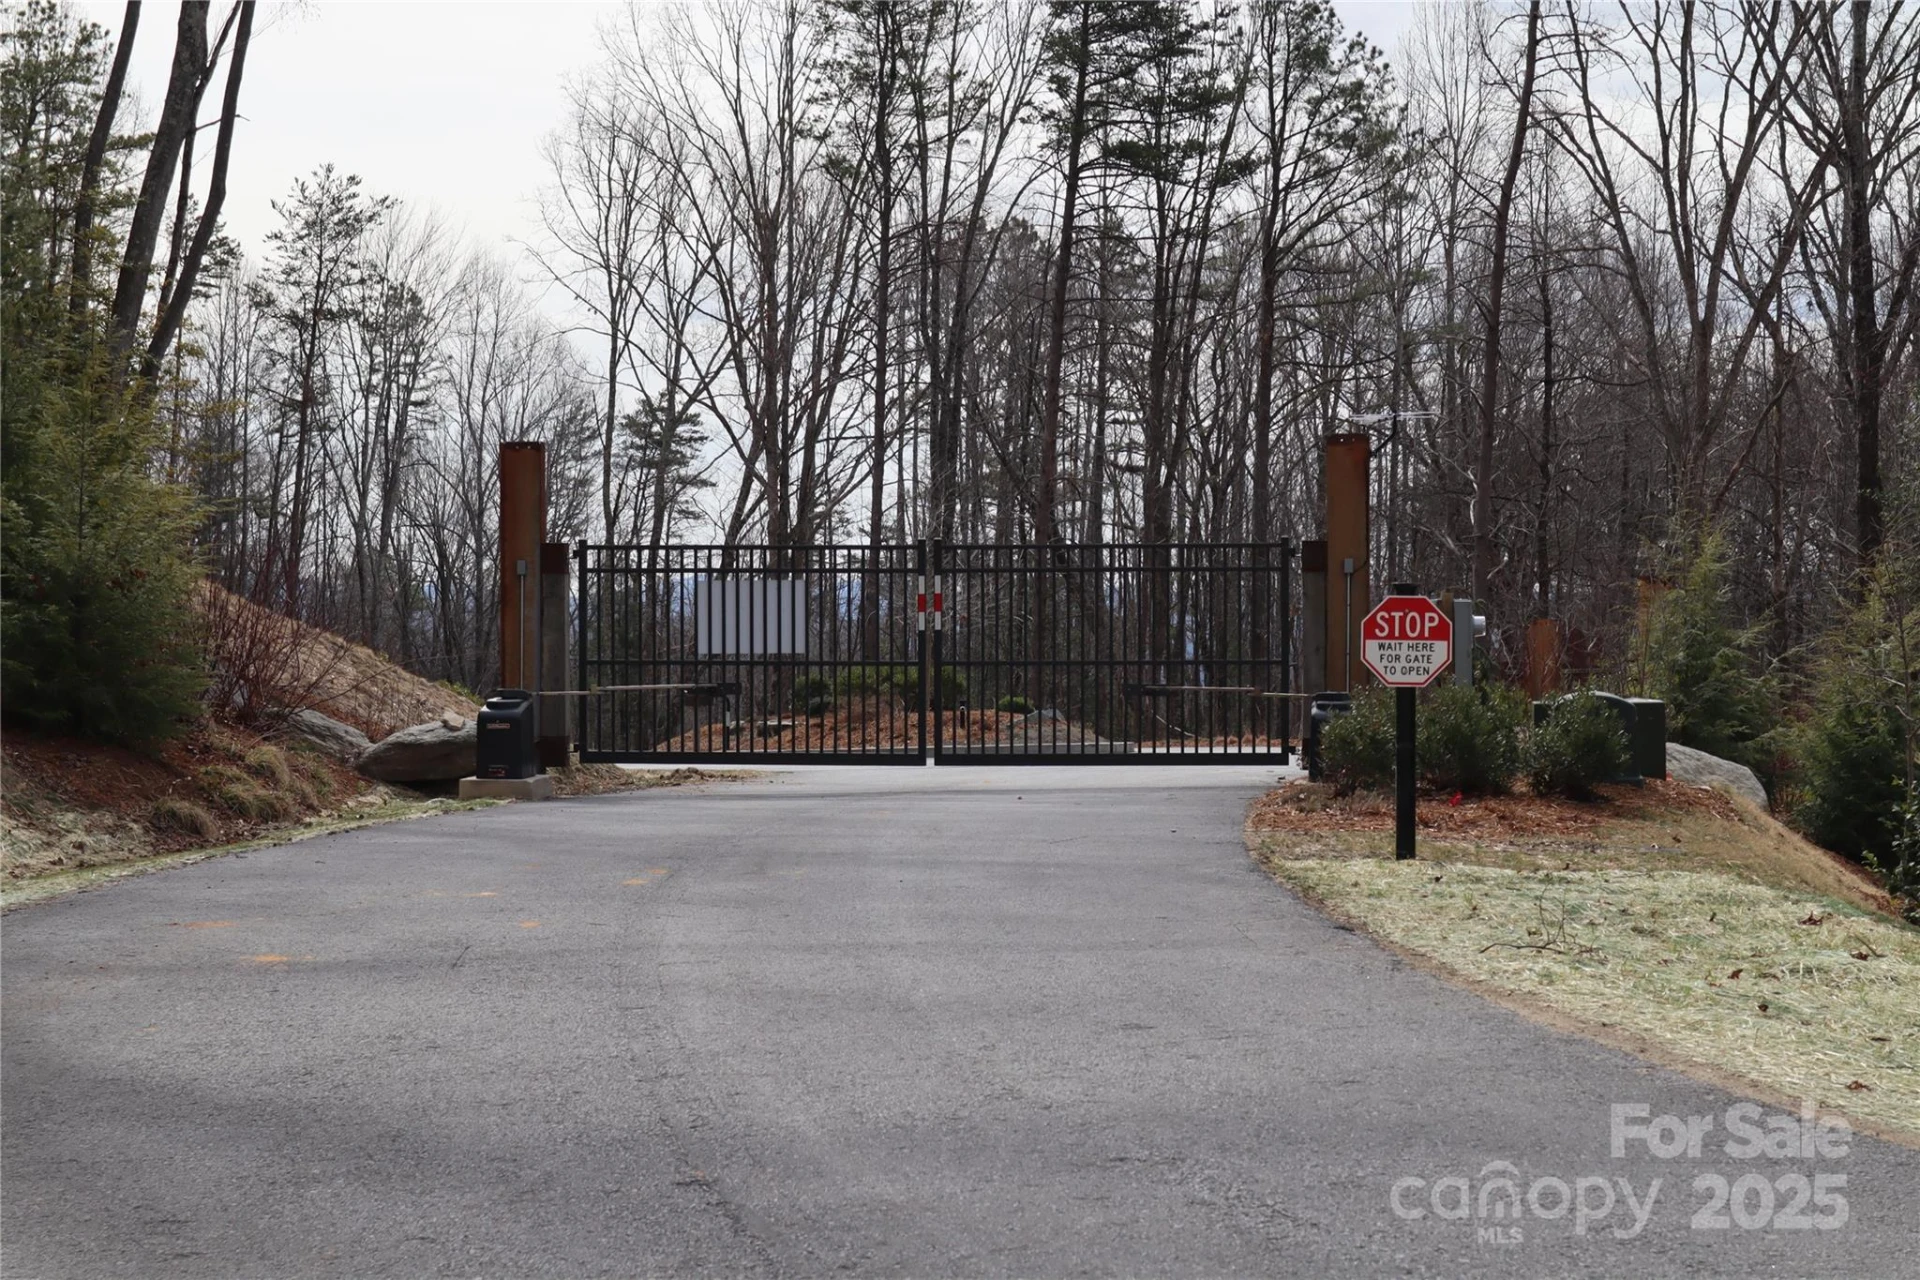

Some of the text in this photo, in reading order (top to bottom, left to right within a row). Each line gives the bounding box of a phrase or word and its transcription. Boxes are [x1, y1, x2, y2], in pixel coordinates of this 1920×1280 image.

[1375, 611, 1440, 638] STOP
[1377, 642, 1435, 652] WAIT HERE
[1380, 654, 1433, 664] FOR GATE
[1383, 665, 1430, 676] TO OPEN
